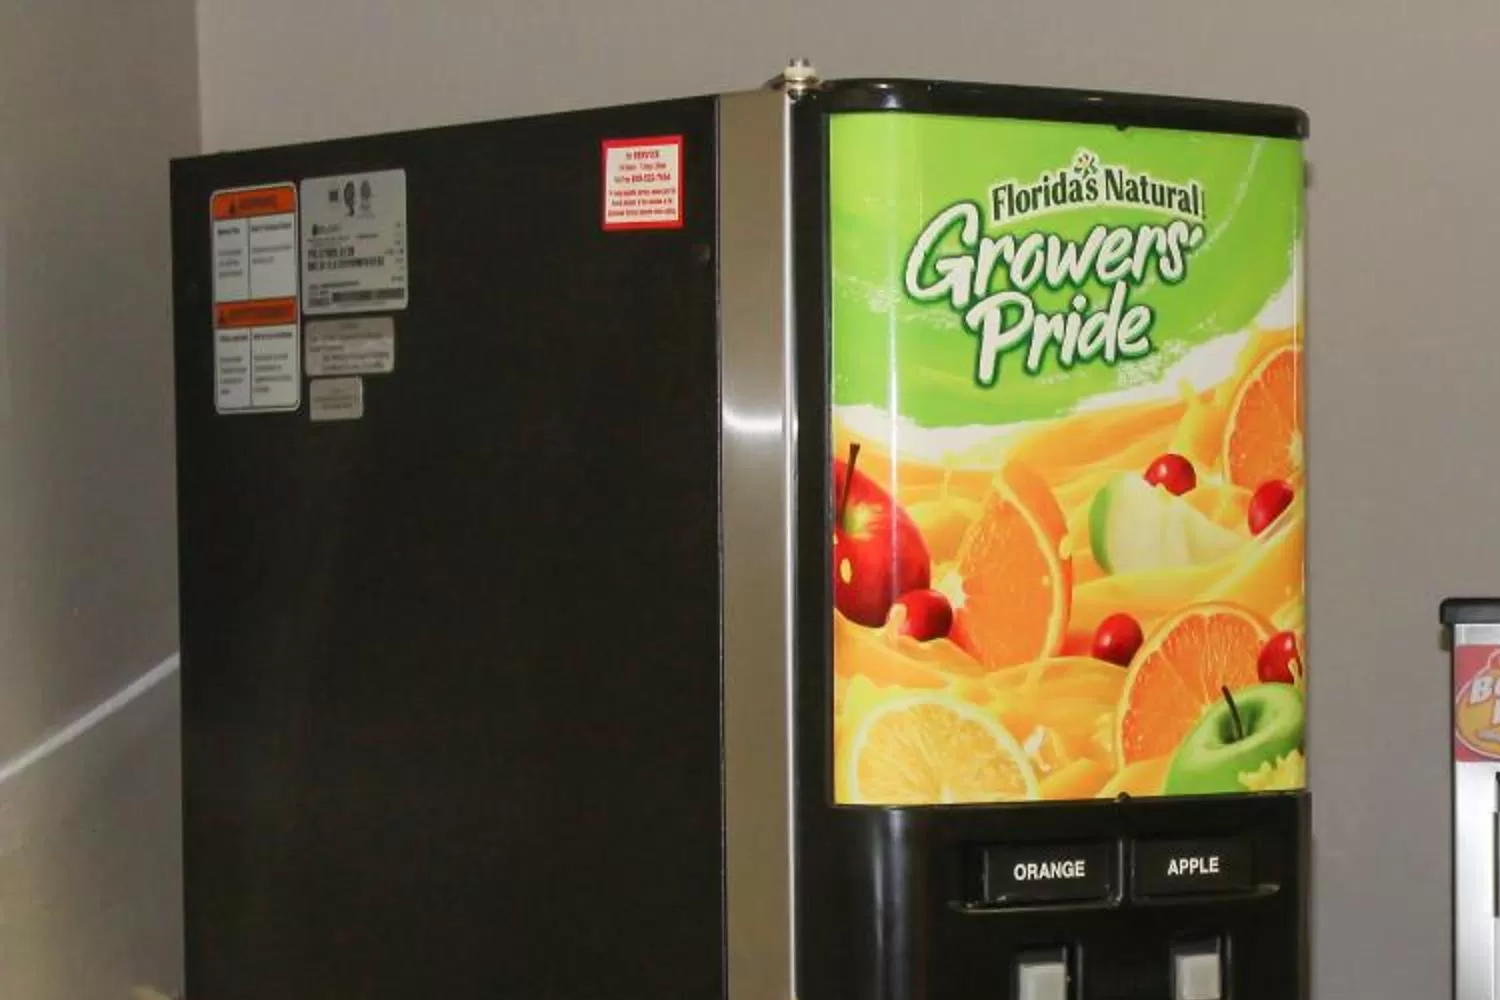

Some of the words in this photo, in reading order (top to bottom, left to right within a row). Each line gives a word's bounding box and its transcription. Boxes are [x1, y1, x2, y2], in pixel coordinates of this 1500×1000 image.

[992, 155, 1100, 221] Florida's
[964, 280, 1153, 386] Pride
[1013, 860, 1086, 882] ORANGE
[1167, 855, 1220, 877] APPLE
